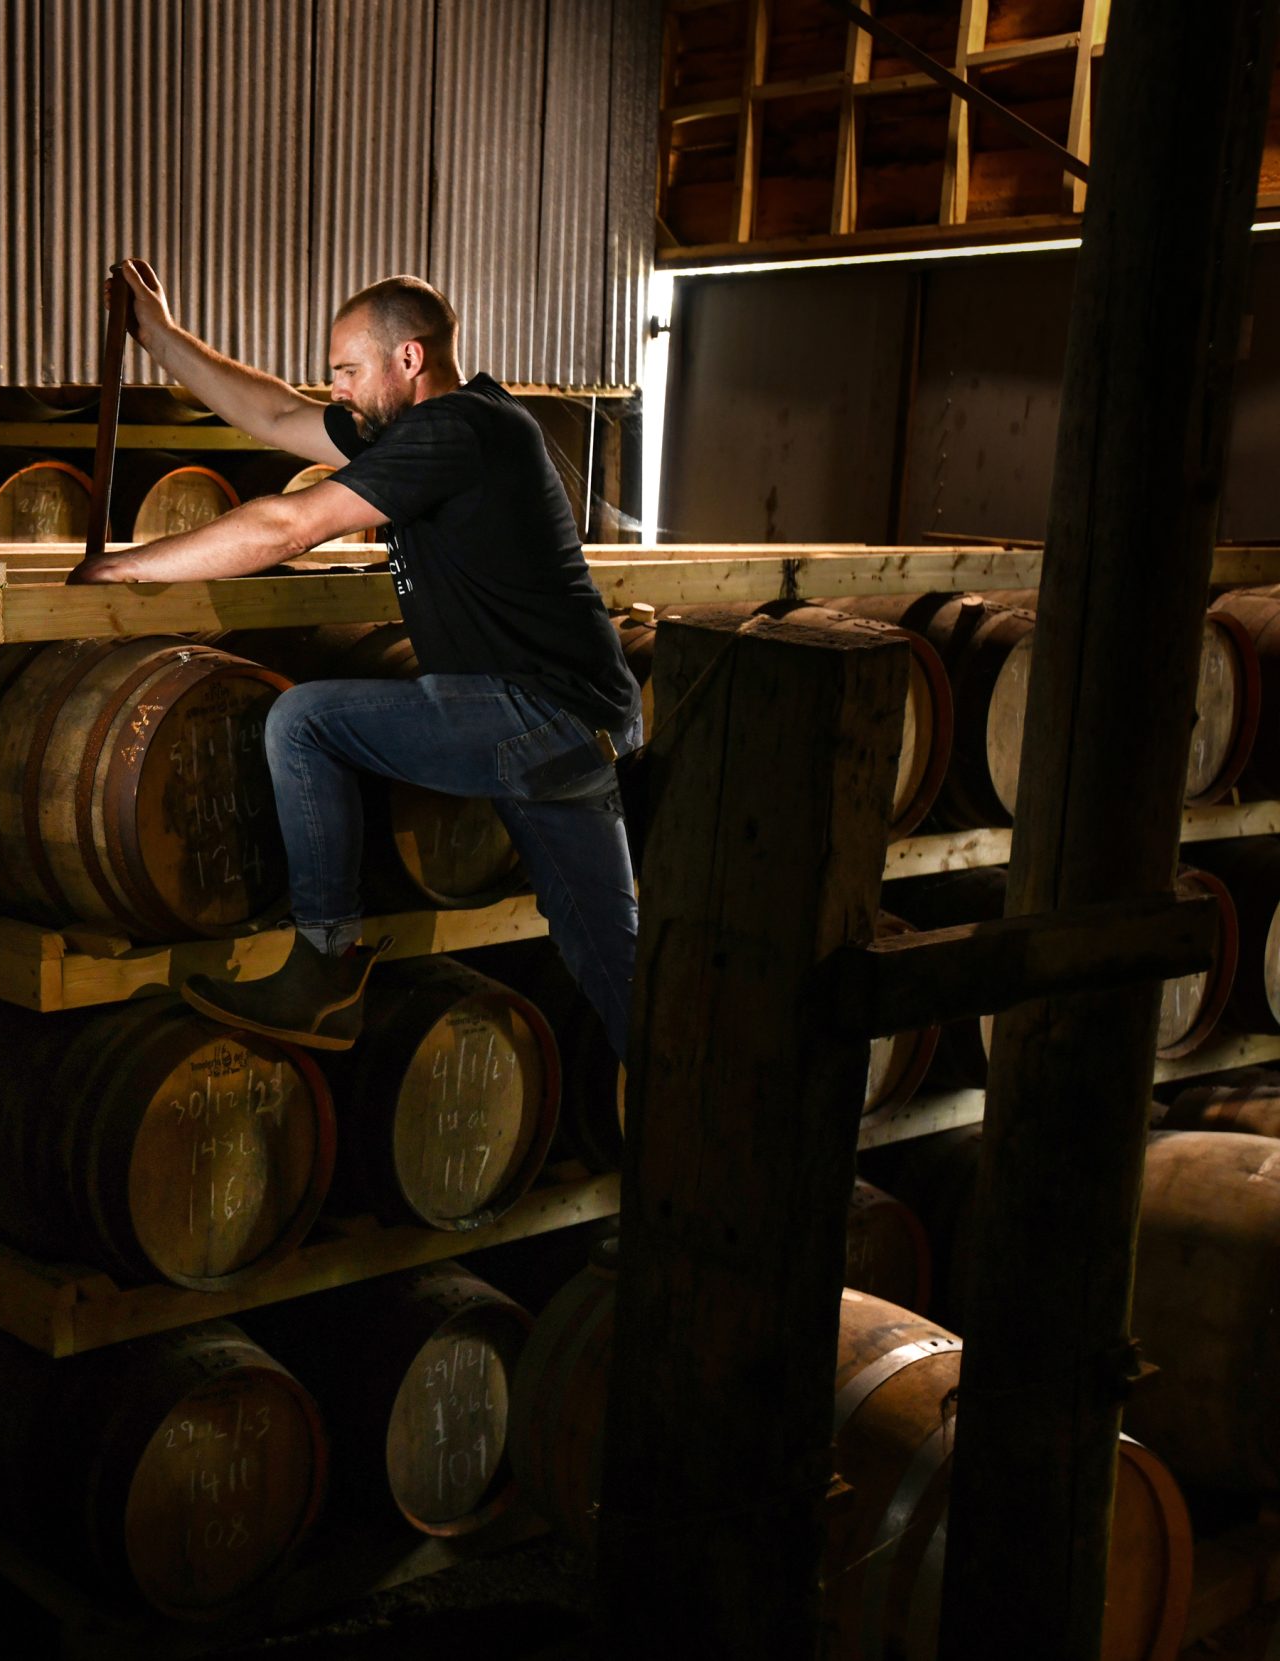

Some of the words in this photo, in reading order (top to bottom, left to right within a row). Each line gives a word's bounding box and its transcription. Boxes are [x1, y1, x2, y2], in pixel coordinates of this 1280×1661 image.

[197, 842, 266, 889] 124
[445, 1146, 491, 1193] 117
[189, 1176, 242, 1235] 116
[186, 1511, 251, 1553] 108
